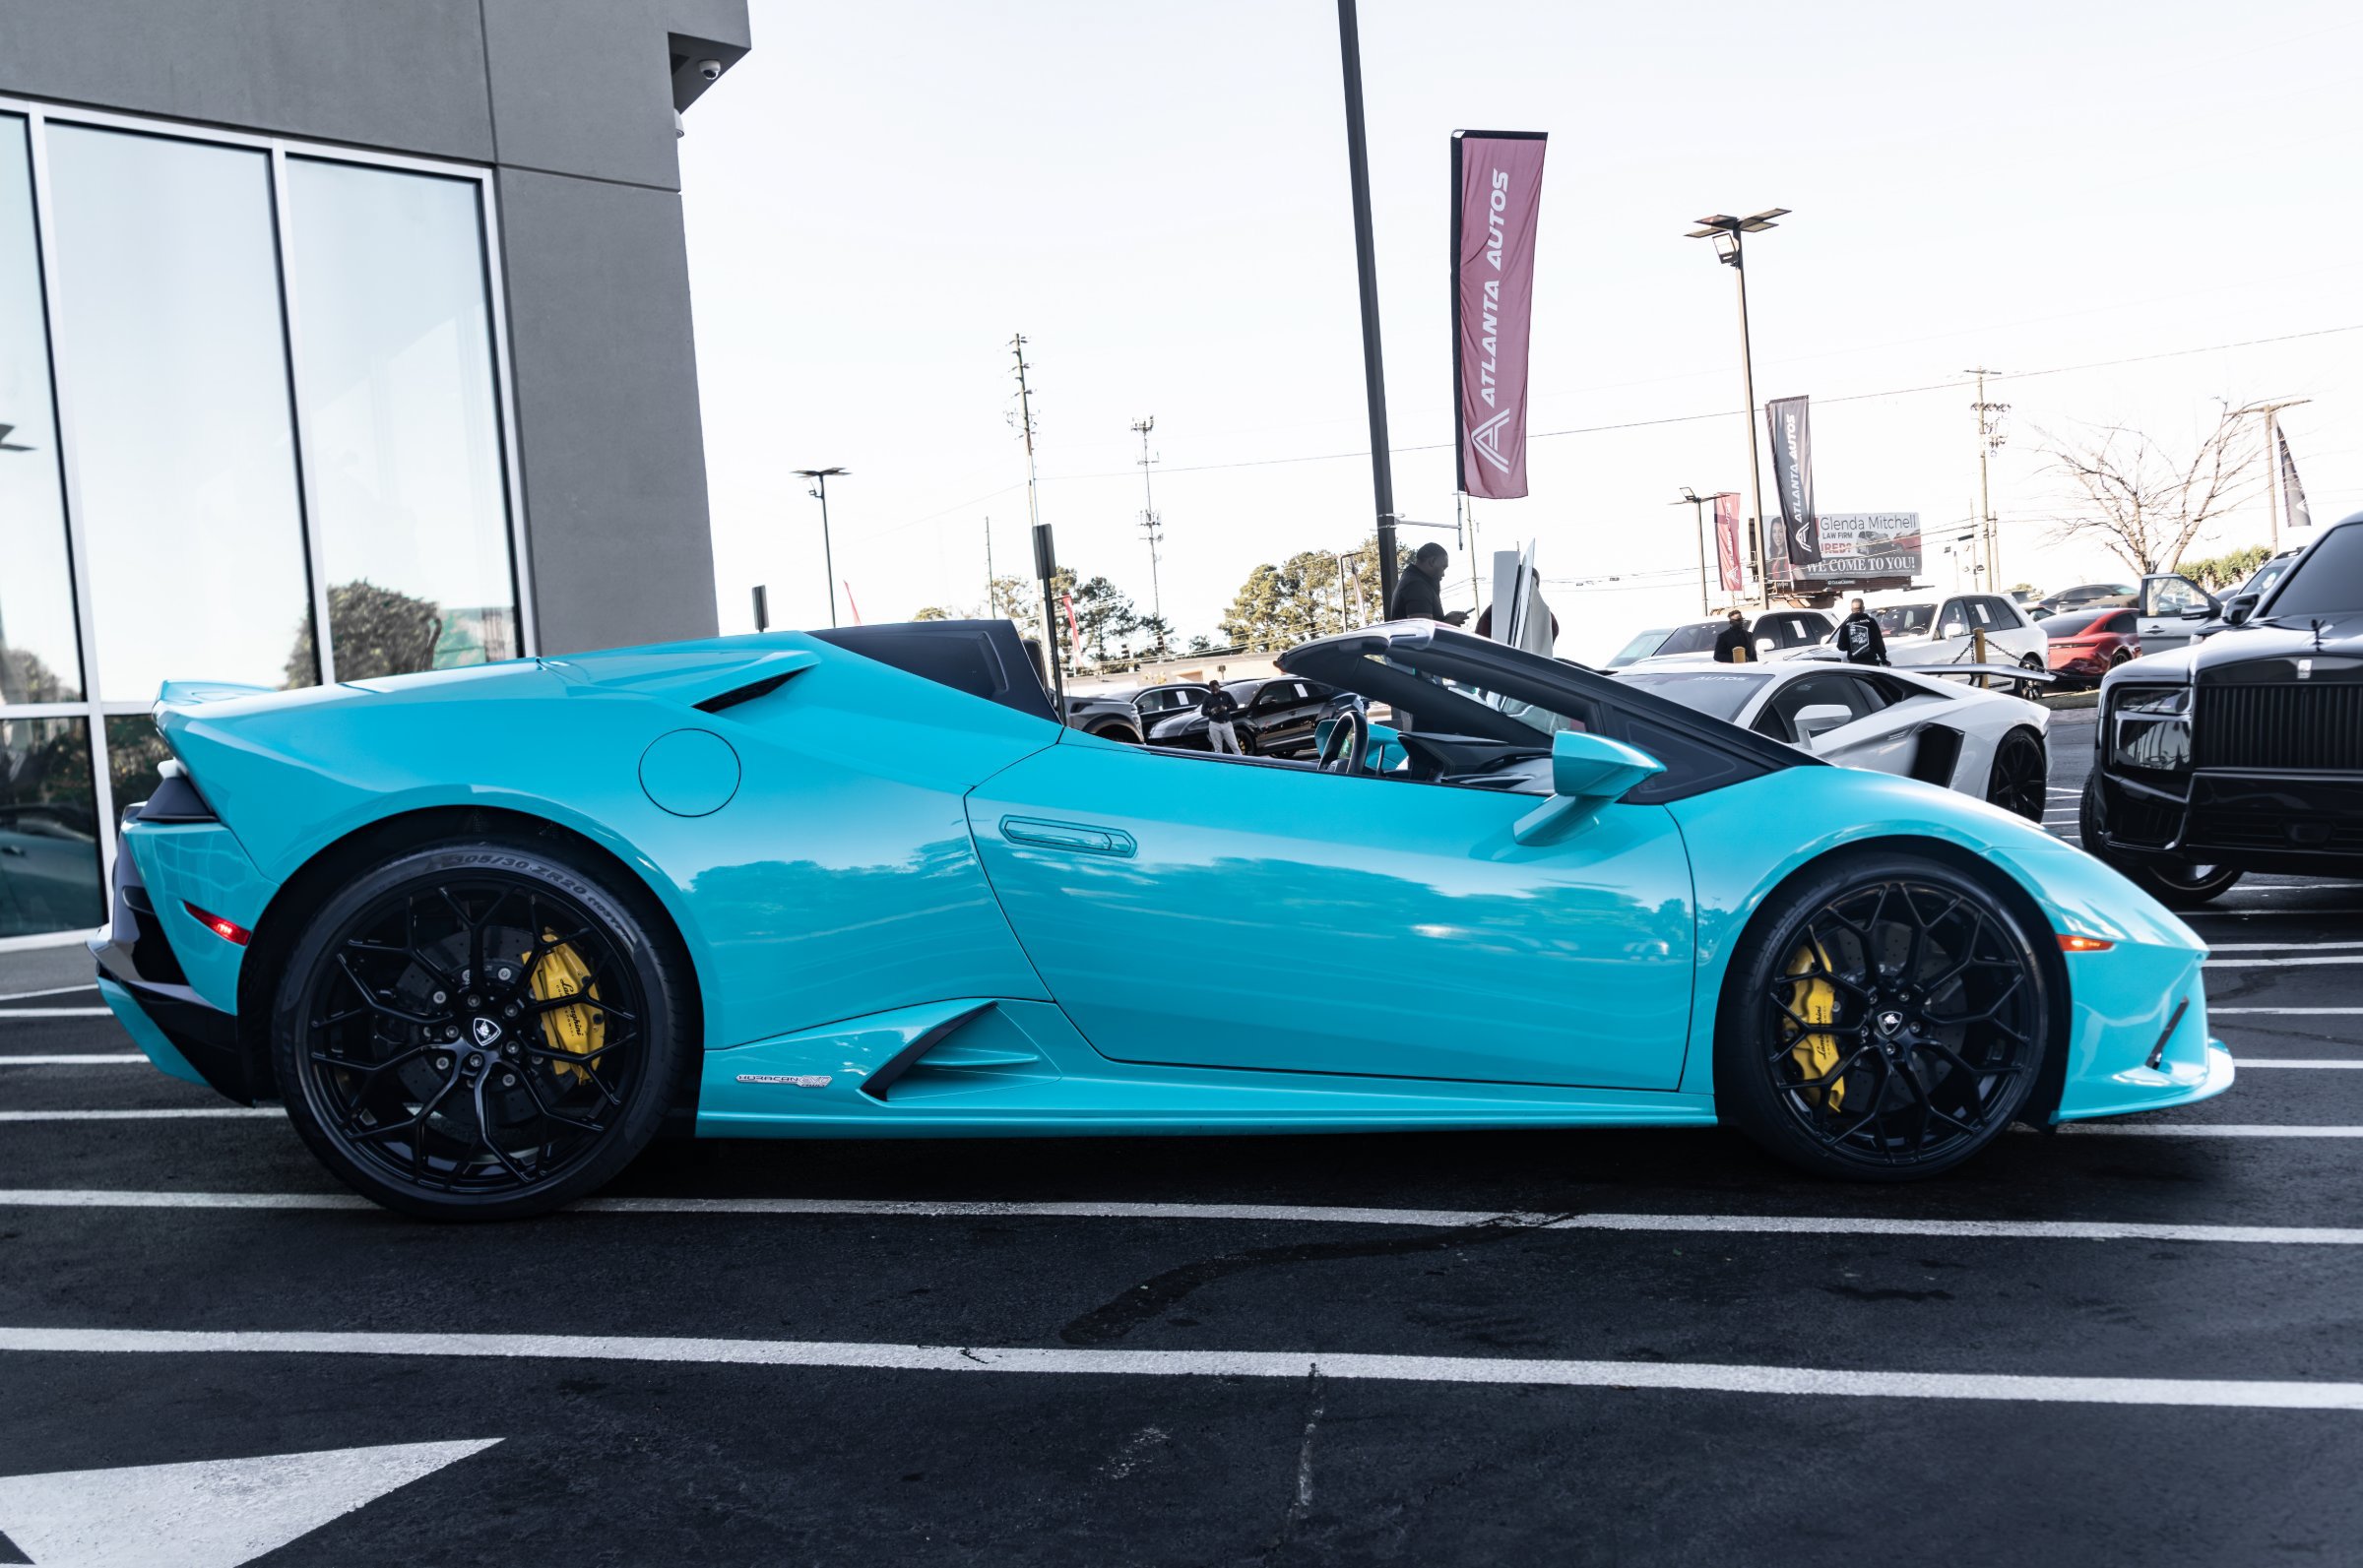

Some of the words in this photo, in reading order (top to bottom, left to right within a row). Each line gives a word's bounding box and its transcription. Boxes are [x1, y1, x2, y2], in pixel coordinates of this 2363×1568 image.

[1486, 167, 1509, 272] AUTOS
[1480, 280, 1500, 408] ATLANTA
[1786, 413, 1798, 461] AUTOS
[1789, 463, 1803, 524] ATLANTA
[1820, 516, 1865, 531] Glenda
[1868, 514, 1917, 530] Mitchell
[1807, 559, 1827, 573] WE
[1829, 558, 1866, 572] COME
[1868, 558, 1884, 571] TO
[1884, 556, 1916, 570] YOU!
[532, 866, 587, 895] ZR20
